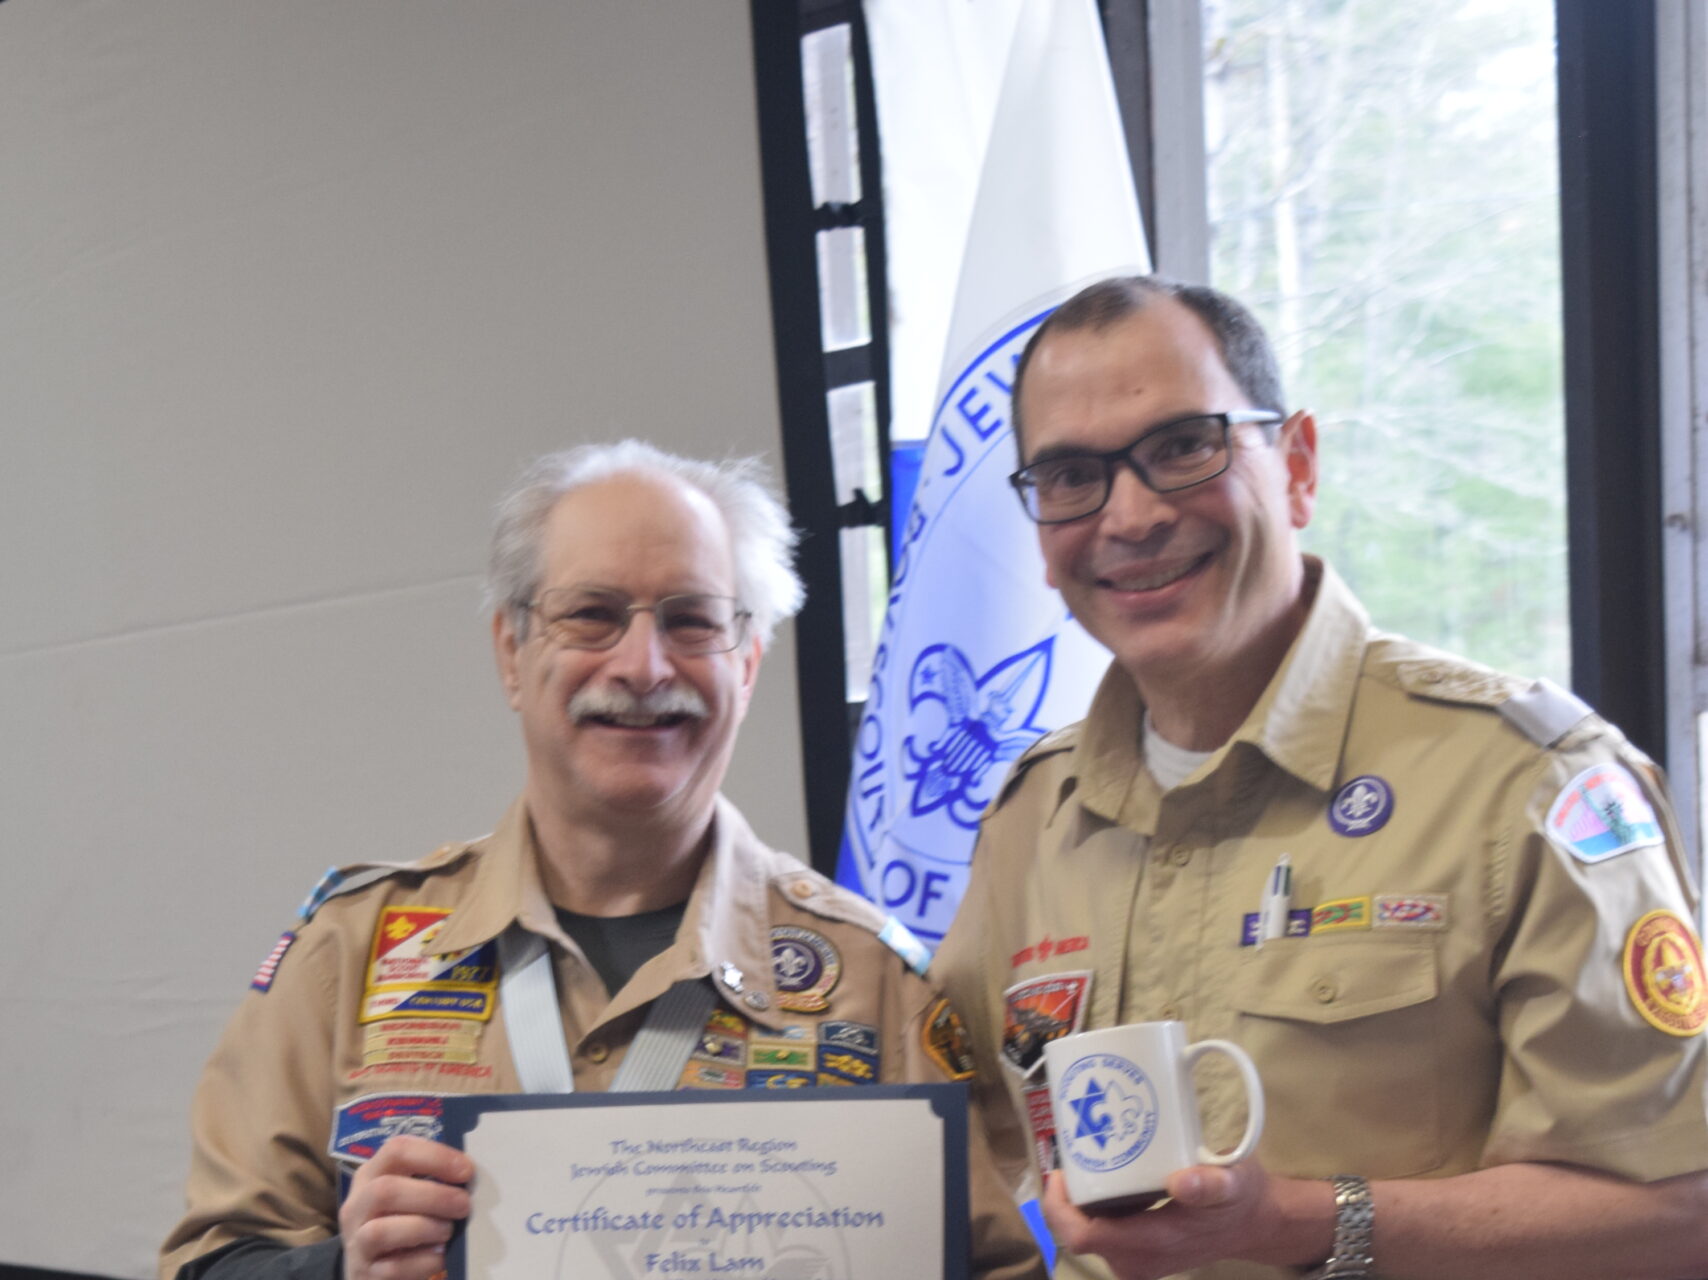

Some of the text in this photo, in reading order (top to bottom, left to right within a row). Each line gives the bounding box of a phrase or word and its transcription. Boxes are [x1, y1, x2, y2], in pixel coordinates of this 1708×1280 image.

[882, 860, 950, 918] OF
[610, 1138, 798, 1156] The Northeast Region
[570, 1159, 838, 1181] Jewish Committee on Scouting
[526, 1204, 886, 1235] Certificate of Appreciation
[645, 1251, 765, 1274] Felix Lam
